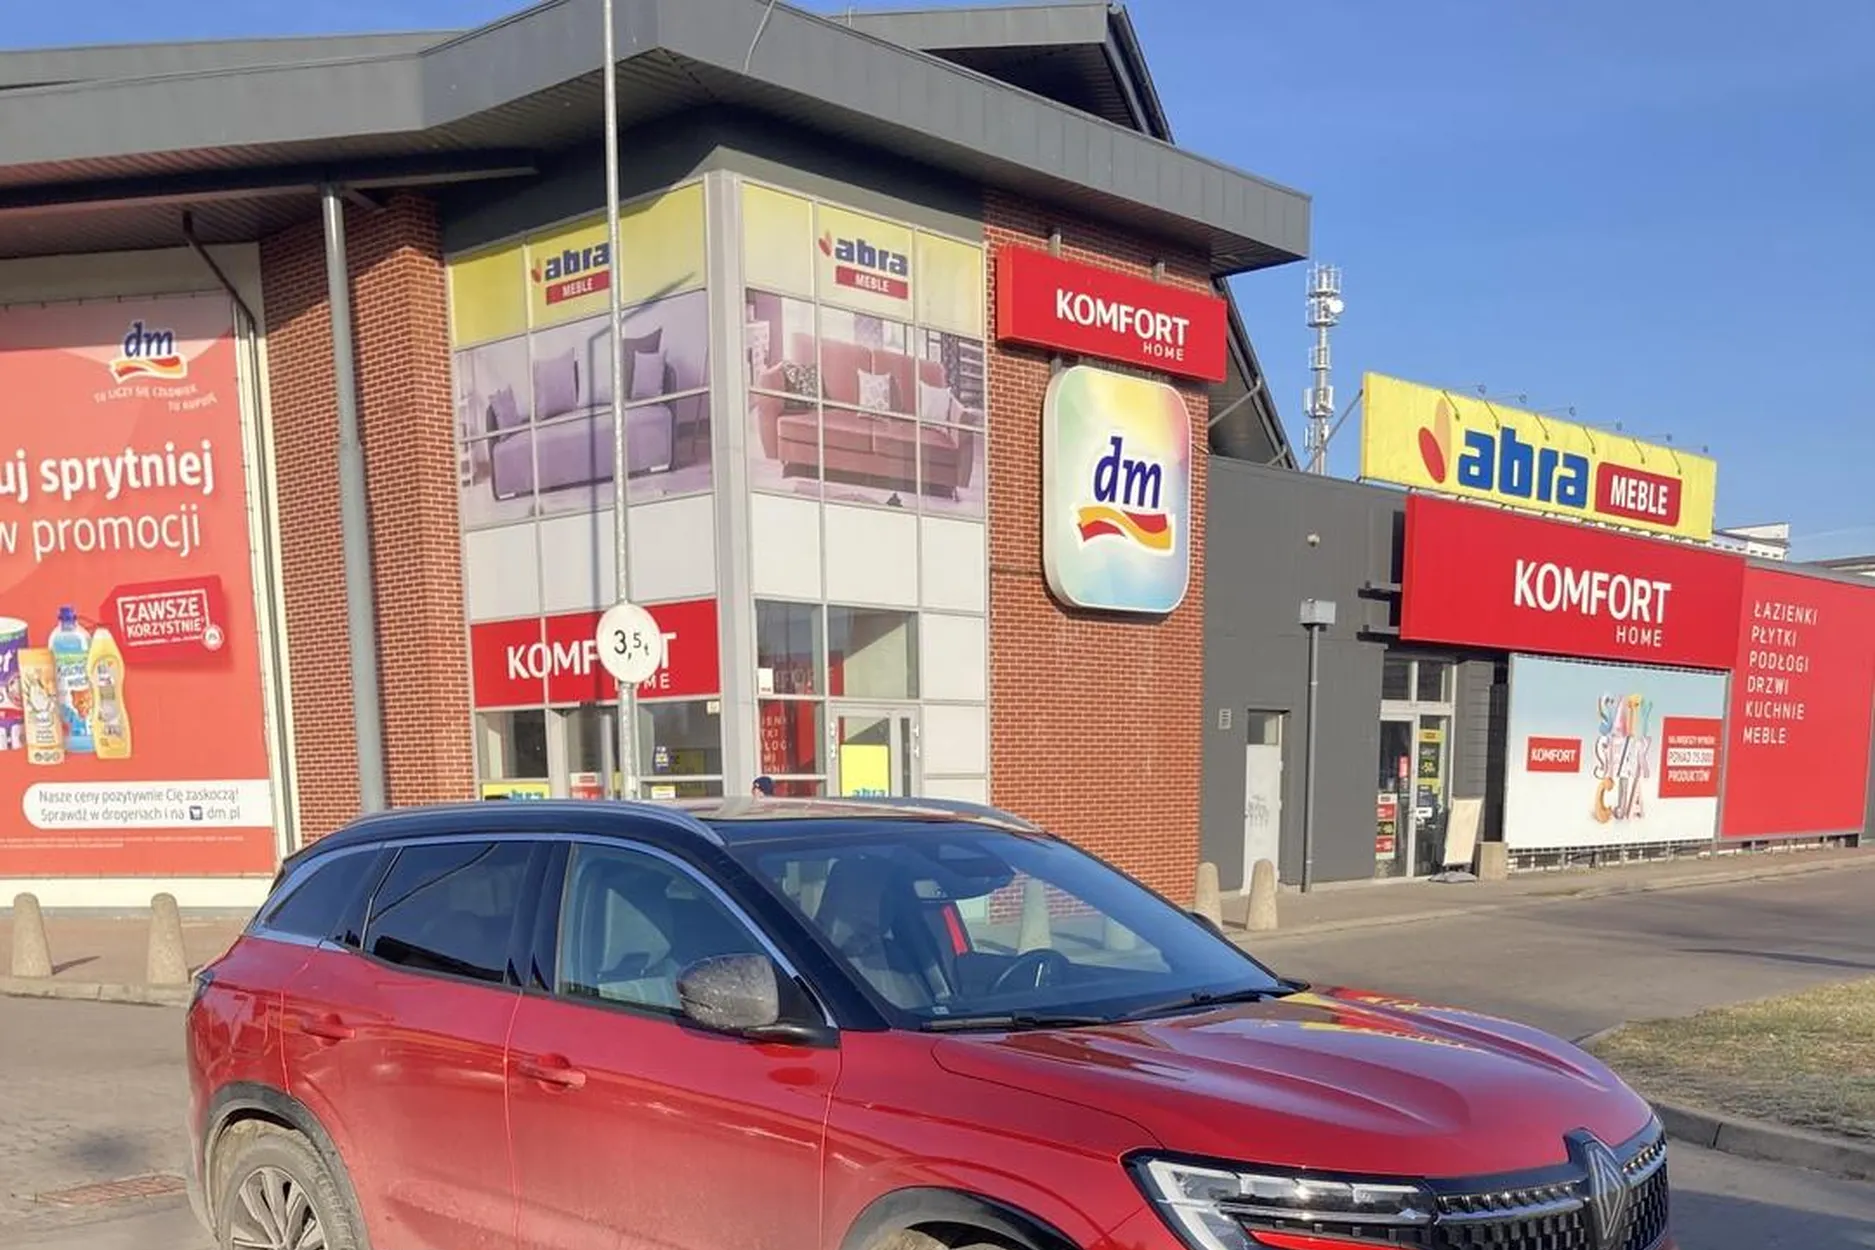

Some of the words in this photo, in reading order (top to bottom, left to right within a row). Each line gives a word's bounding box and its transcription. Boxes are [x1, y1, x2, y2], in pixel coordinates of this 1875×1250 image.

[835, 237, 908, 277] abra
[562, 278, 592, 297] MEBLE
[855, 273, 890, 293] MEBLE
[1055, 289, 1190, 346] KOMFORT
[124, 322, 173, 357] dm
[1142, 342, 1185, 360] HOME
[40, 439, 214, 502] sprytniej
[1093, 436, 1162, 510] dm
[1458, 425, 1590, 510] abra
[1611, 474, 1668, 516] MEBLE
[32, 503, 201, 563] promocji
[1514, 558, 1672, 625] KOMFORT
[124, 597, 201, 623] ZAWSZE
[1754, 600, 1819, 626] ŁAZIENKI
[1616, 625, 1663, 648] HOME
[1751, 625, 1797, 647] PŁYTKI
[507, 632, 677, 680] KOMFT
[1748, 650, 1810, 673] PODŁOGI
[1747, 675, 1789, 696] DRZWI
[1745, 701, 1806, 720] KUCHNIE
[1743, 725, 1787, 745] MEBLE
[1531, 748, 1577, 764] KOMFORT
[39, 790, 72, 804] Nasze
[74, 792, 100, 805] ceny
[101, 789, 163, 805] pozytywnie
[90, 811, 100, 821] w
[101, 806, 162, 823] drogeriach
[170, 809, 185, 820] na
